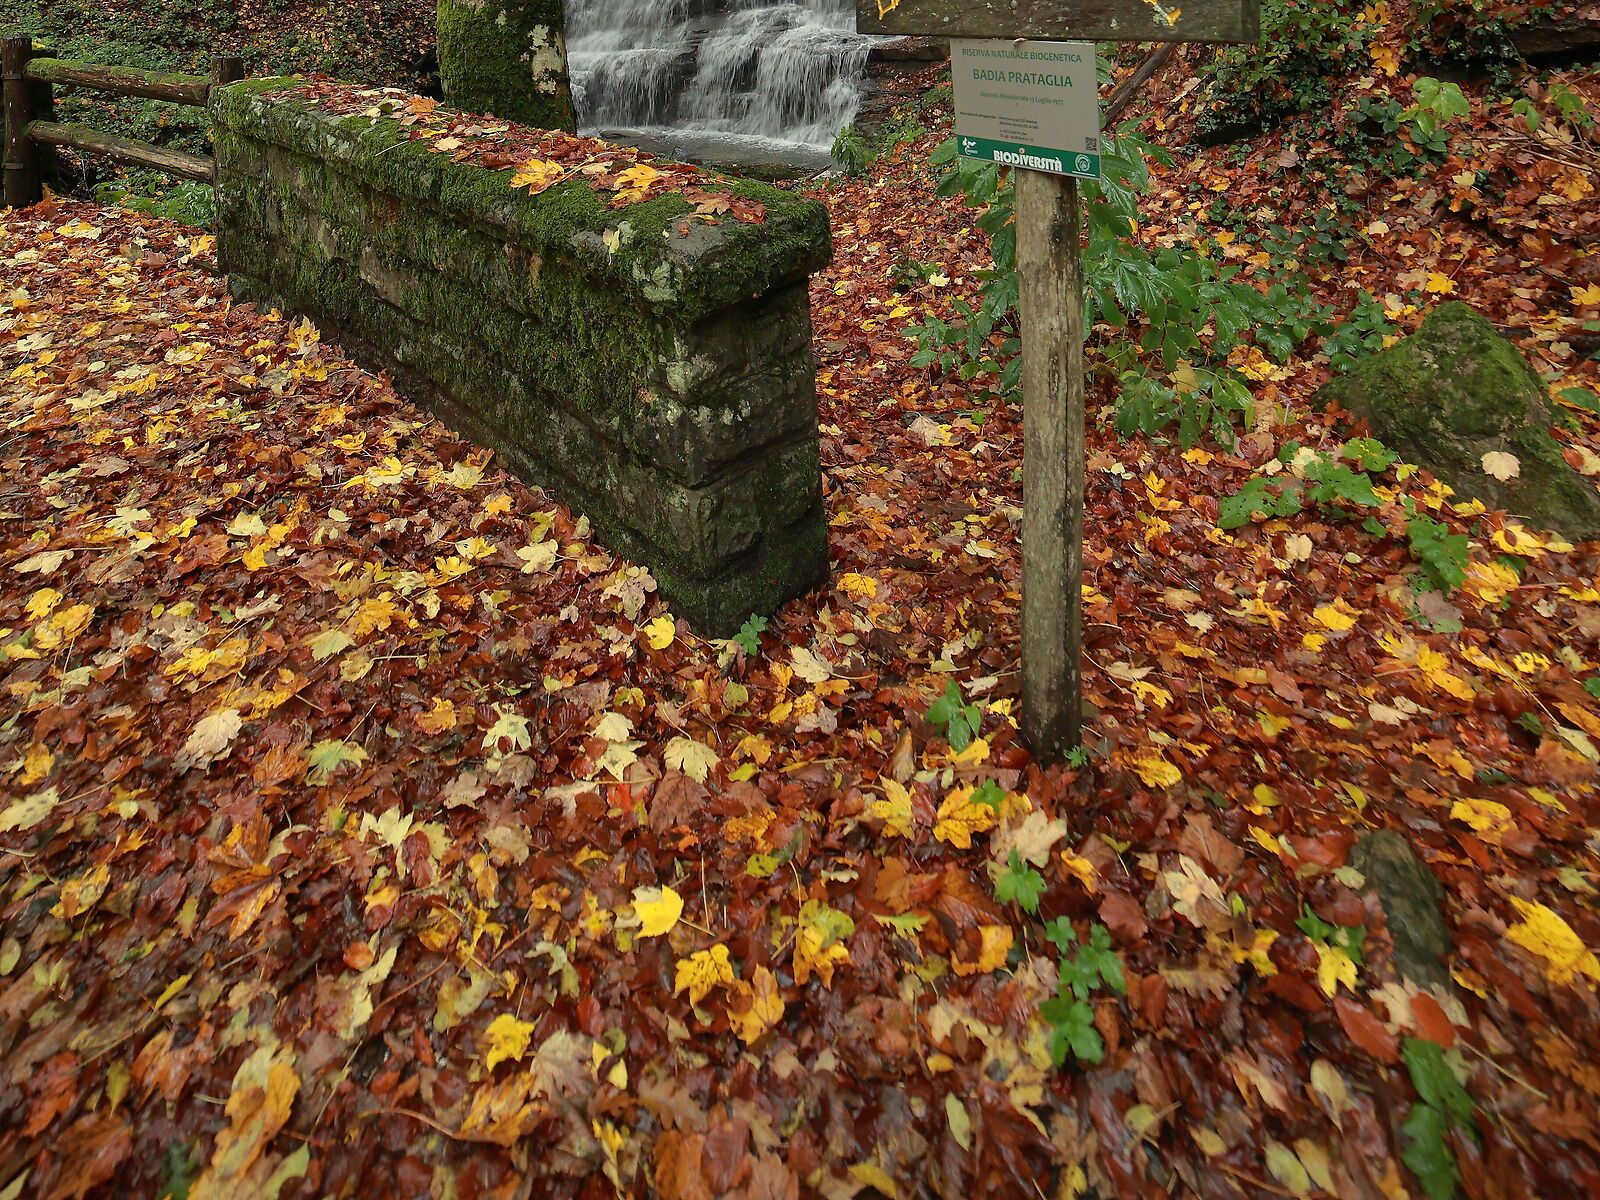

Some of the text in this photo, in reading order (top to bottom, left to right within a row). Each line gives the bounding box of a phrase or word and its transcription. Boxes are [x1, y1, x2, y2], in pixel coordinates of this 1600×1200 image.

[962, 48, 1082, 63] RISERVA NATURALE BIOGENETICA
[973, 69, 1073, 87] BADIA PRATAGLIA
